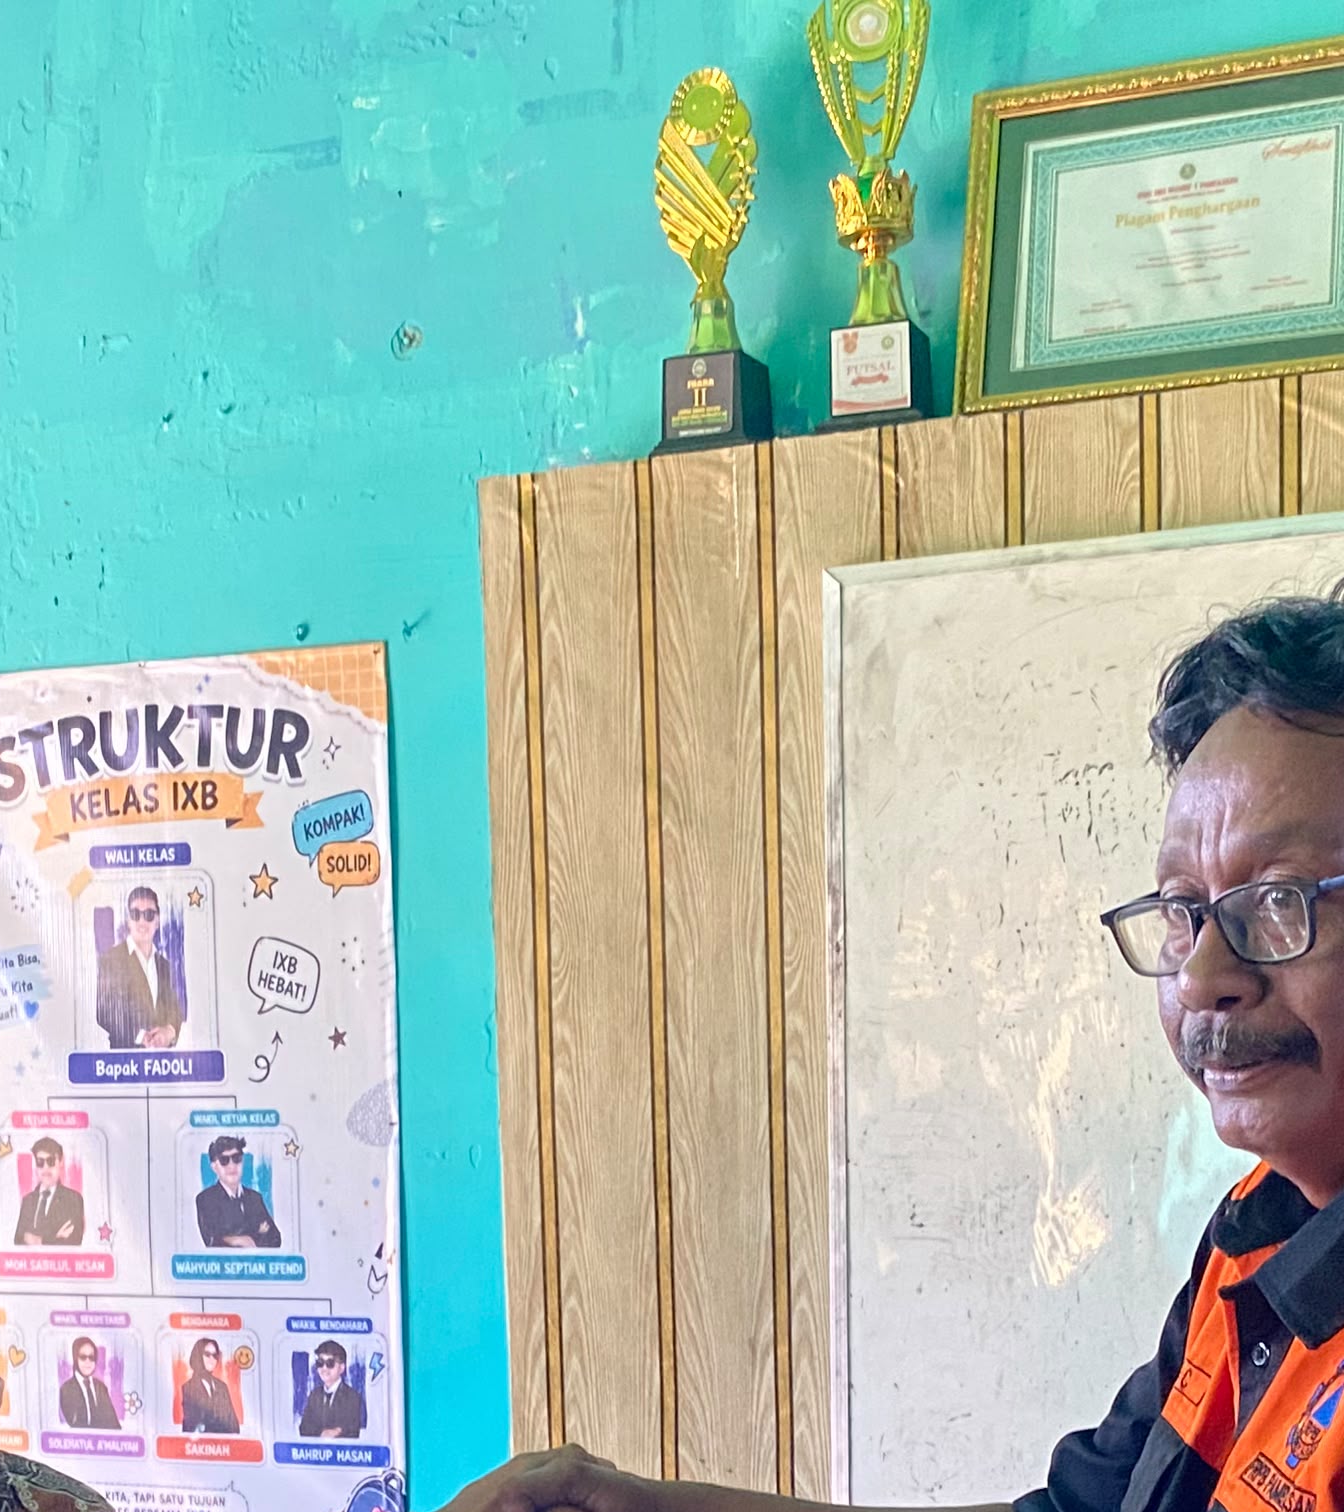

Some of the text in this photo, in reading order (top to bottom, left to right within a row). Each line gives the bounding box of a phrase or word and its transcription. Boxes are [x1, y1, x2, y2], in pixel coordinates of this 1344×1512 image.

[1115, 210, 1165, 229] Piagam
[1168, 196, 1261, 220] Penghargaan
[847, 361, 896, 376] FUTSAL
[69, 780, 219, 822] KELAS IXB
[303, 803, 366, 842] KOMPAK!
[105, 847, 176, 864] WALI KELAS
[326, 852, 372, 873] SOLID!
[17, 953, 41, 967] Bisa,
[272, 950, 298, 975] IXB
[11, 980, 34, 995] Kita
[257, 969, 308, 1003] HEBAT!
[95, 1057, 193, 1080] Bapak FADOLI
[249, 1112, 277, 1125] KELAS
[175, 1260, 303, 1275] WAHYUDI SEPTIAN EFENDI
[184, 1442, 230, 1457] SAKINAH
[291, 1448, 373, 1463] BAHRUP HASAN
[133, 1491, 156, 1503] TAPI
